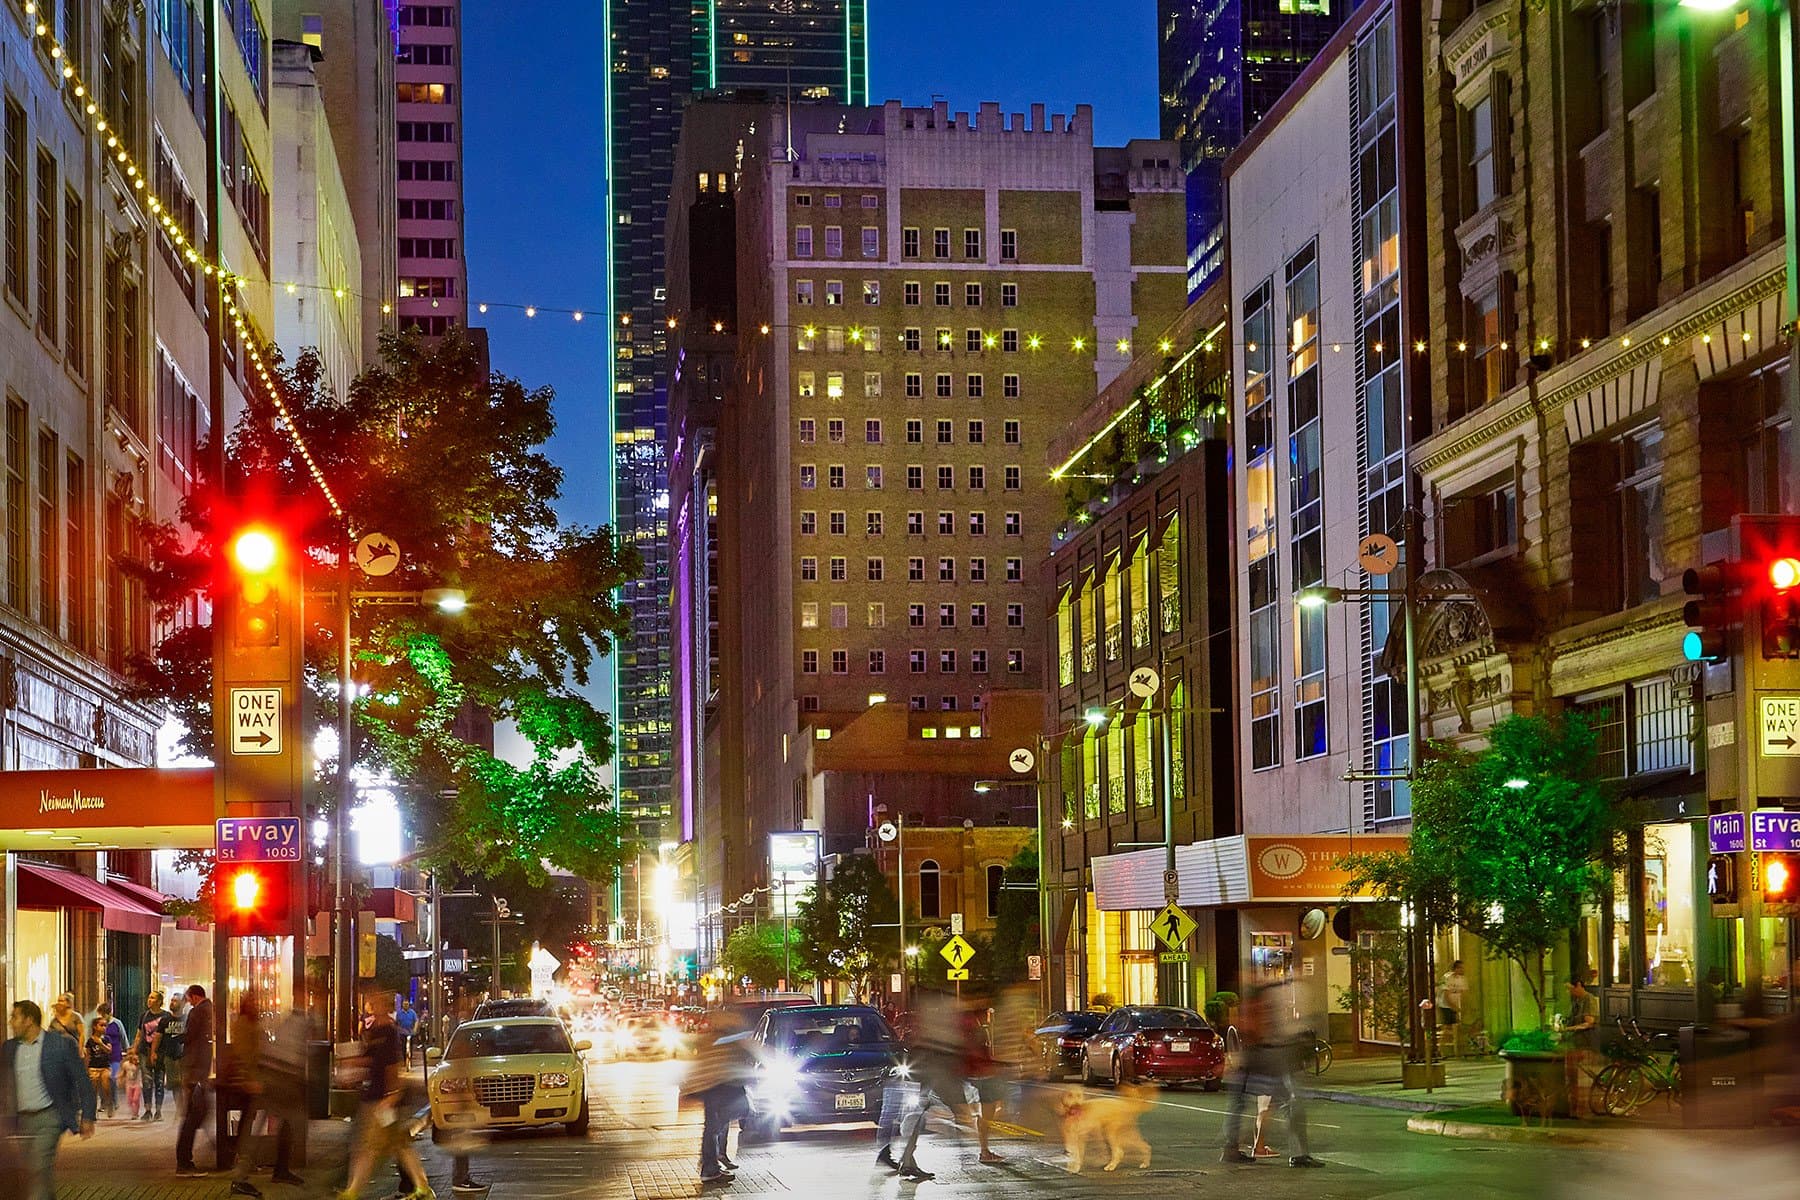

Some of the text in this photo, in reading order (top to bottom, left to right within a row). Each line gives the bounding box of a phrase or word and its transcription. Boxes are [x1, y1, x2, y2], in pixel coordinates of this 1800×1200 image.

[238, 695, 275, 709] ONE
[1766, 703, 1797, 716] ONE
[238, 713, 275, 727] WAY
[1766, 719, 1798, 732] WAY
[39, 789, 105, 813] Neiman Marcus
[1713, 816, 1740, 835] Main
[221, 823, 296, 845] Ervay
[1711, 841, 1718, 850] St
[1755, 838, 1767, 848] St
[222, 847, 296, 859] St 100S
[1310, 851, 1340, 861] THE
[1274, 853, 1291, 870] W
